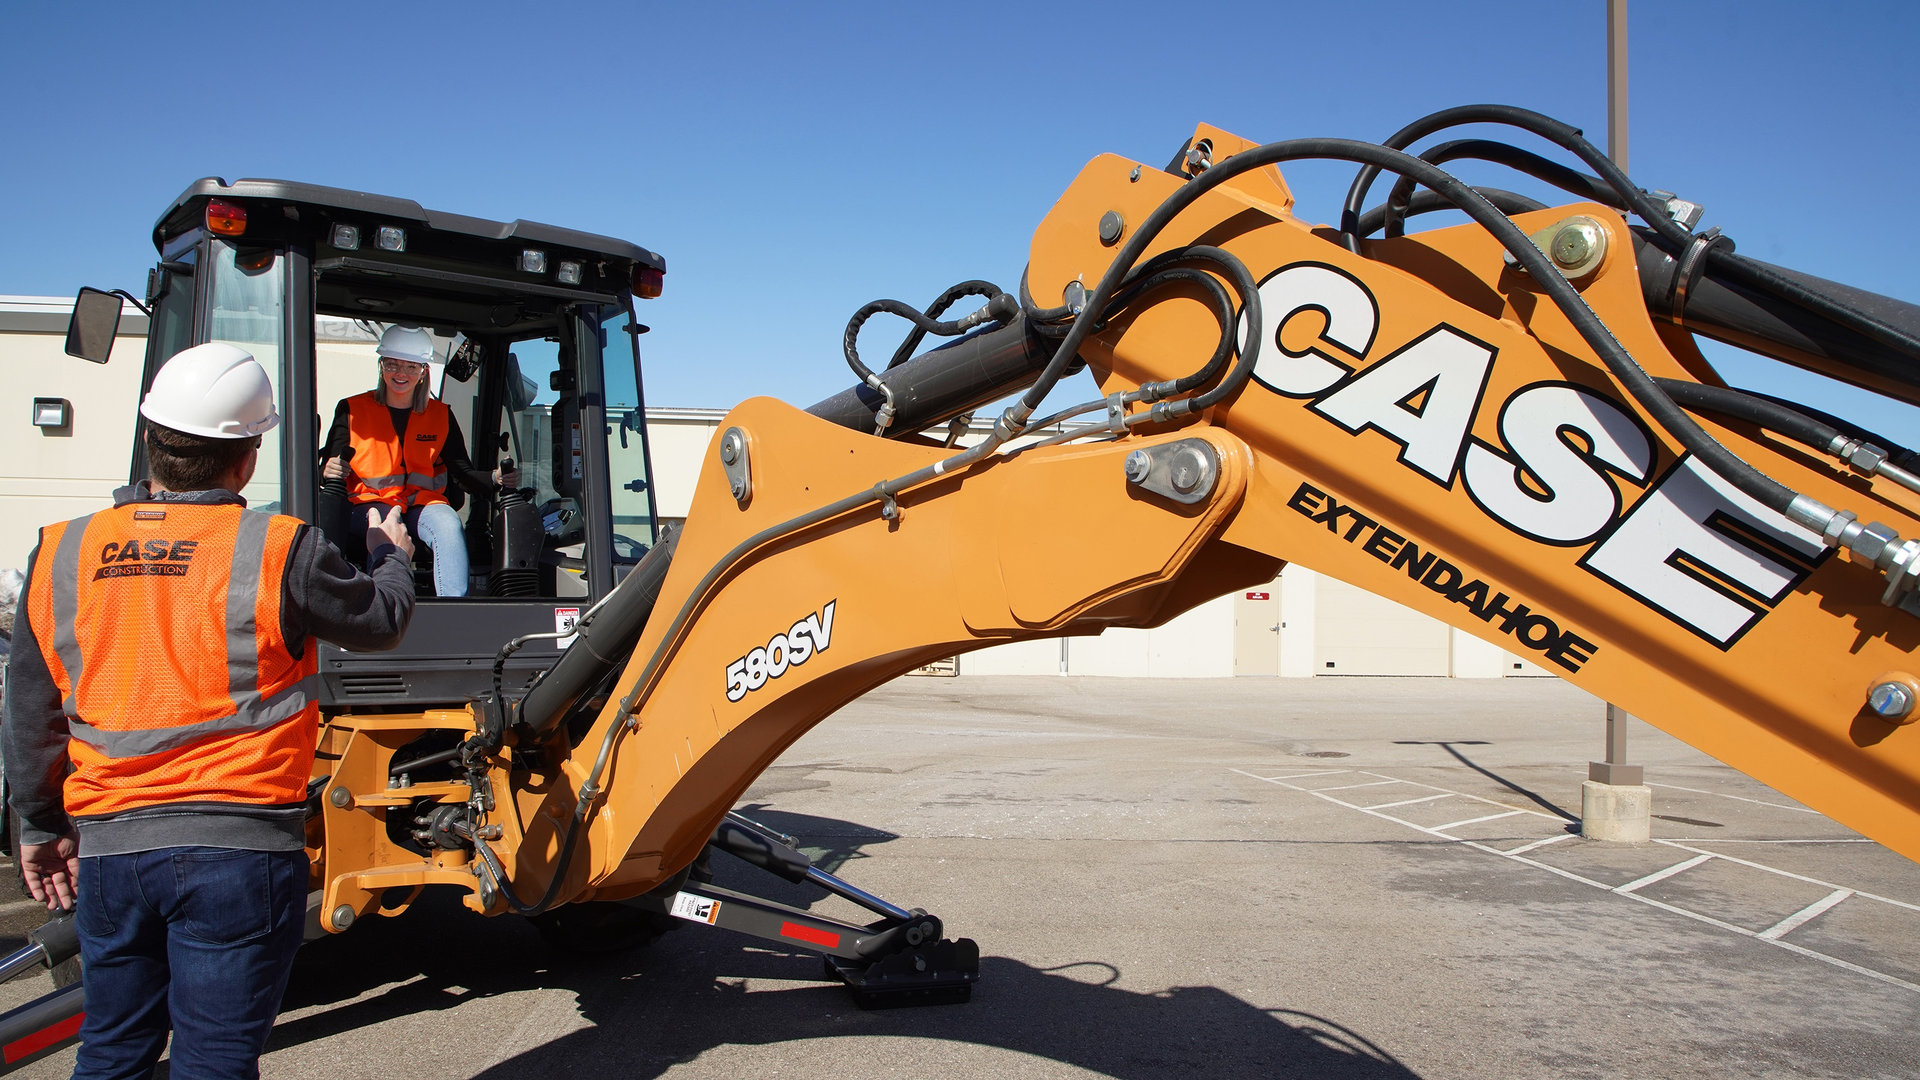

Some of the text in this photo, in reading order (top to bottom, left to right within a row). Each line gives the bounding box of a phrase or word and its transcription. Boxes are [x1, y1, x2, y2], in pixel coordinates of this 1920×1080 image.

[1236, 261, 1837, 651] CASE
[101, 539, 199, 564] CASE
[102, 566, 184, 577] CONSTRUCTION
[1286, 481, 1599, 674] EXTENDAHOE
[726, 598, 837, 703] 580SV
